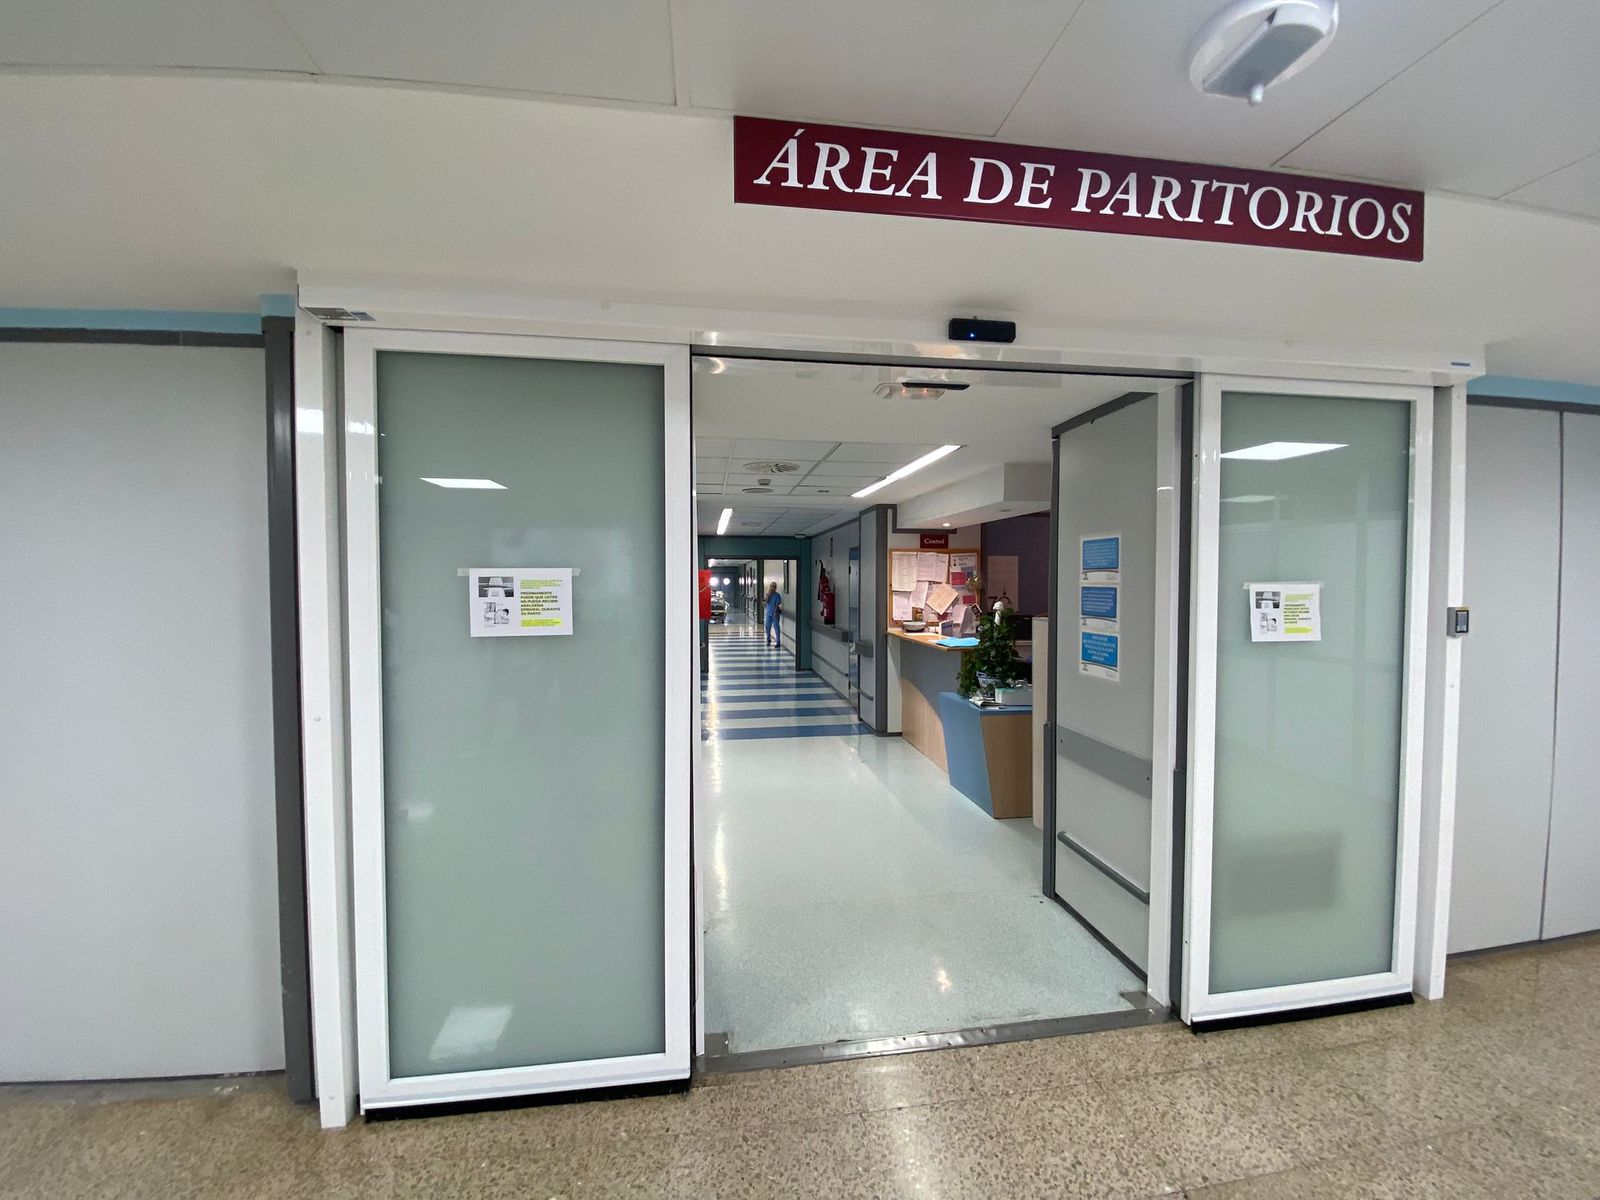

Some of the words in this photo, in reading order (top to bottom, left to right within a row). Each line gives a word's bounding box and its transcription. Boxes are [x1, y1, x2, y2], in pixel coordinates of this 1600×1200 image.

[754, 131, 942, 199] ÁREA
[963, 158, 1055, 208] DE
[1071, 169, 1411, 243] PARITORIOS
